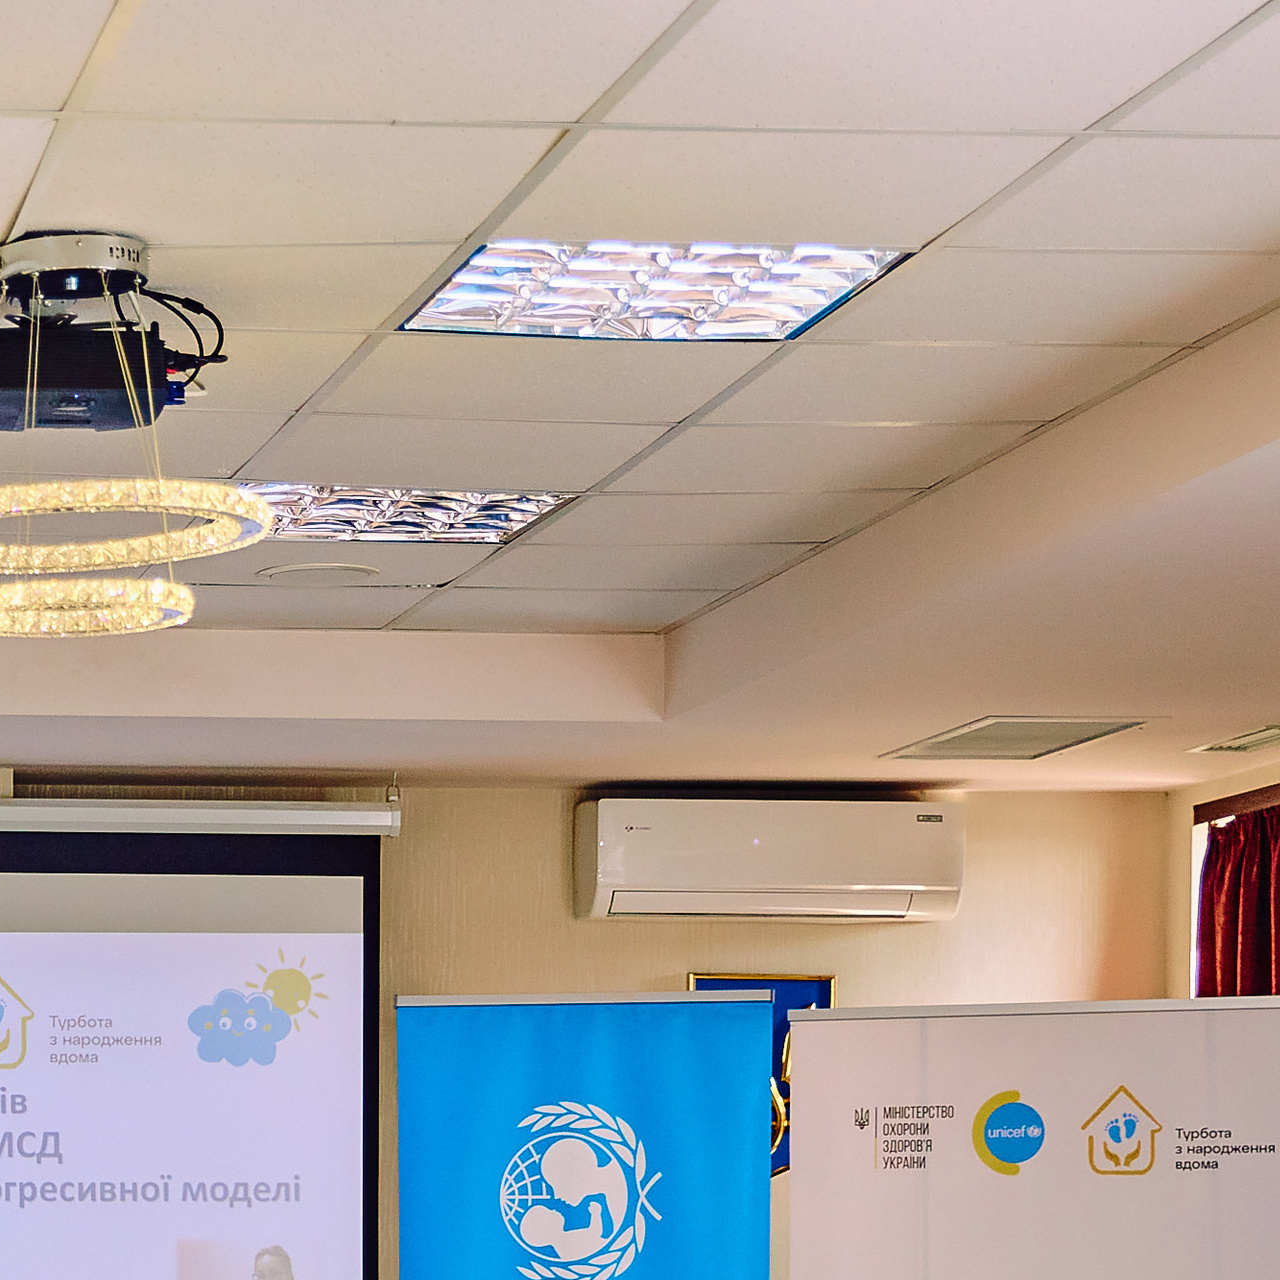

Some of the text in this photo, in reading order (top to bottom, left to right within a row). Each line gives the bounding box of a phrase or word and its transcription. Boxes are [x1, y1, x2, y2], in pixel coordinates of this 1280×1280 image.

[50, 1015, 113, 1032] Турбота
[50, 1033, 162, 1049] з народження
[50, 1051, 99, 1066] вдома
[882, 1105, 955, 1120] МІНІСТЕРСТВО
[882, 1122, 930, 1136] ОХОРОНИ
[987, 1125, 1027, 1138] unicef
[1175, 1127, 1232, 1142] Турбота
[882, 1139, 933, 1153] ЗДОРОВ'Я
[1175, 1144, 1276, 1157] з народження
[882, 1155, 926, 1170] УКРАЇНИ
[1175, 1160, 1219, 1171] вдома
[183, 1175, 301, 1208] моделі
